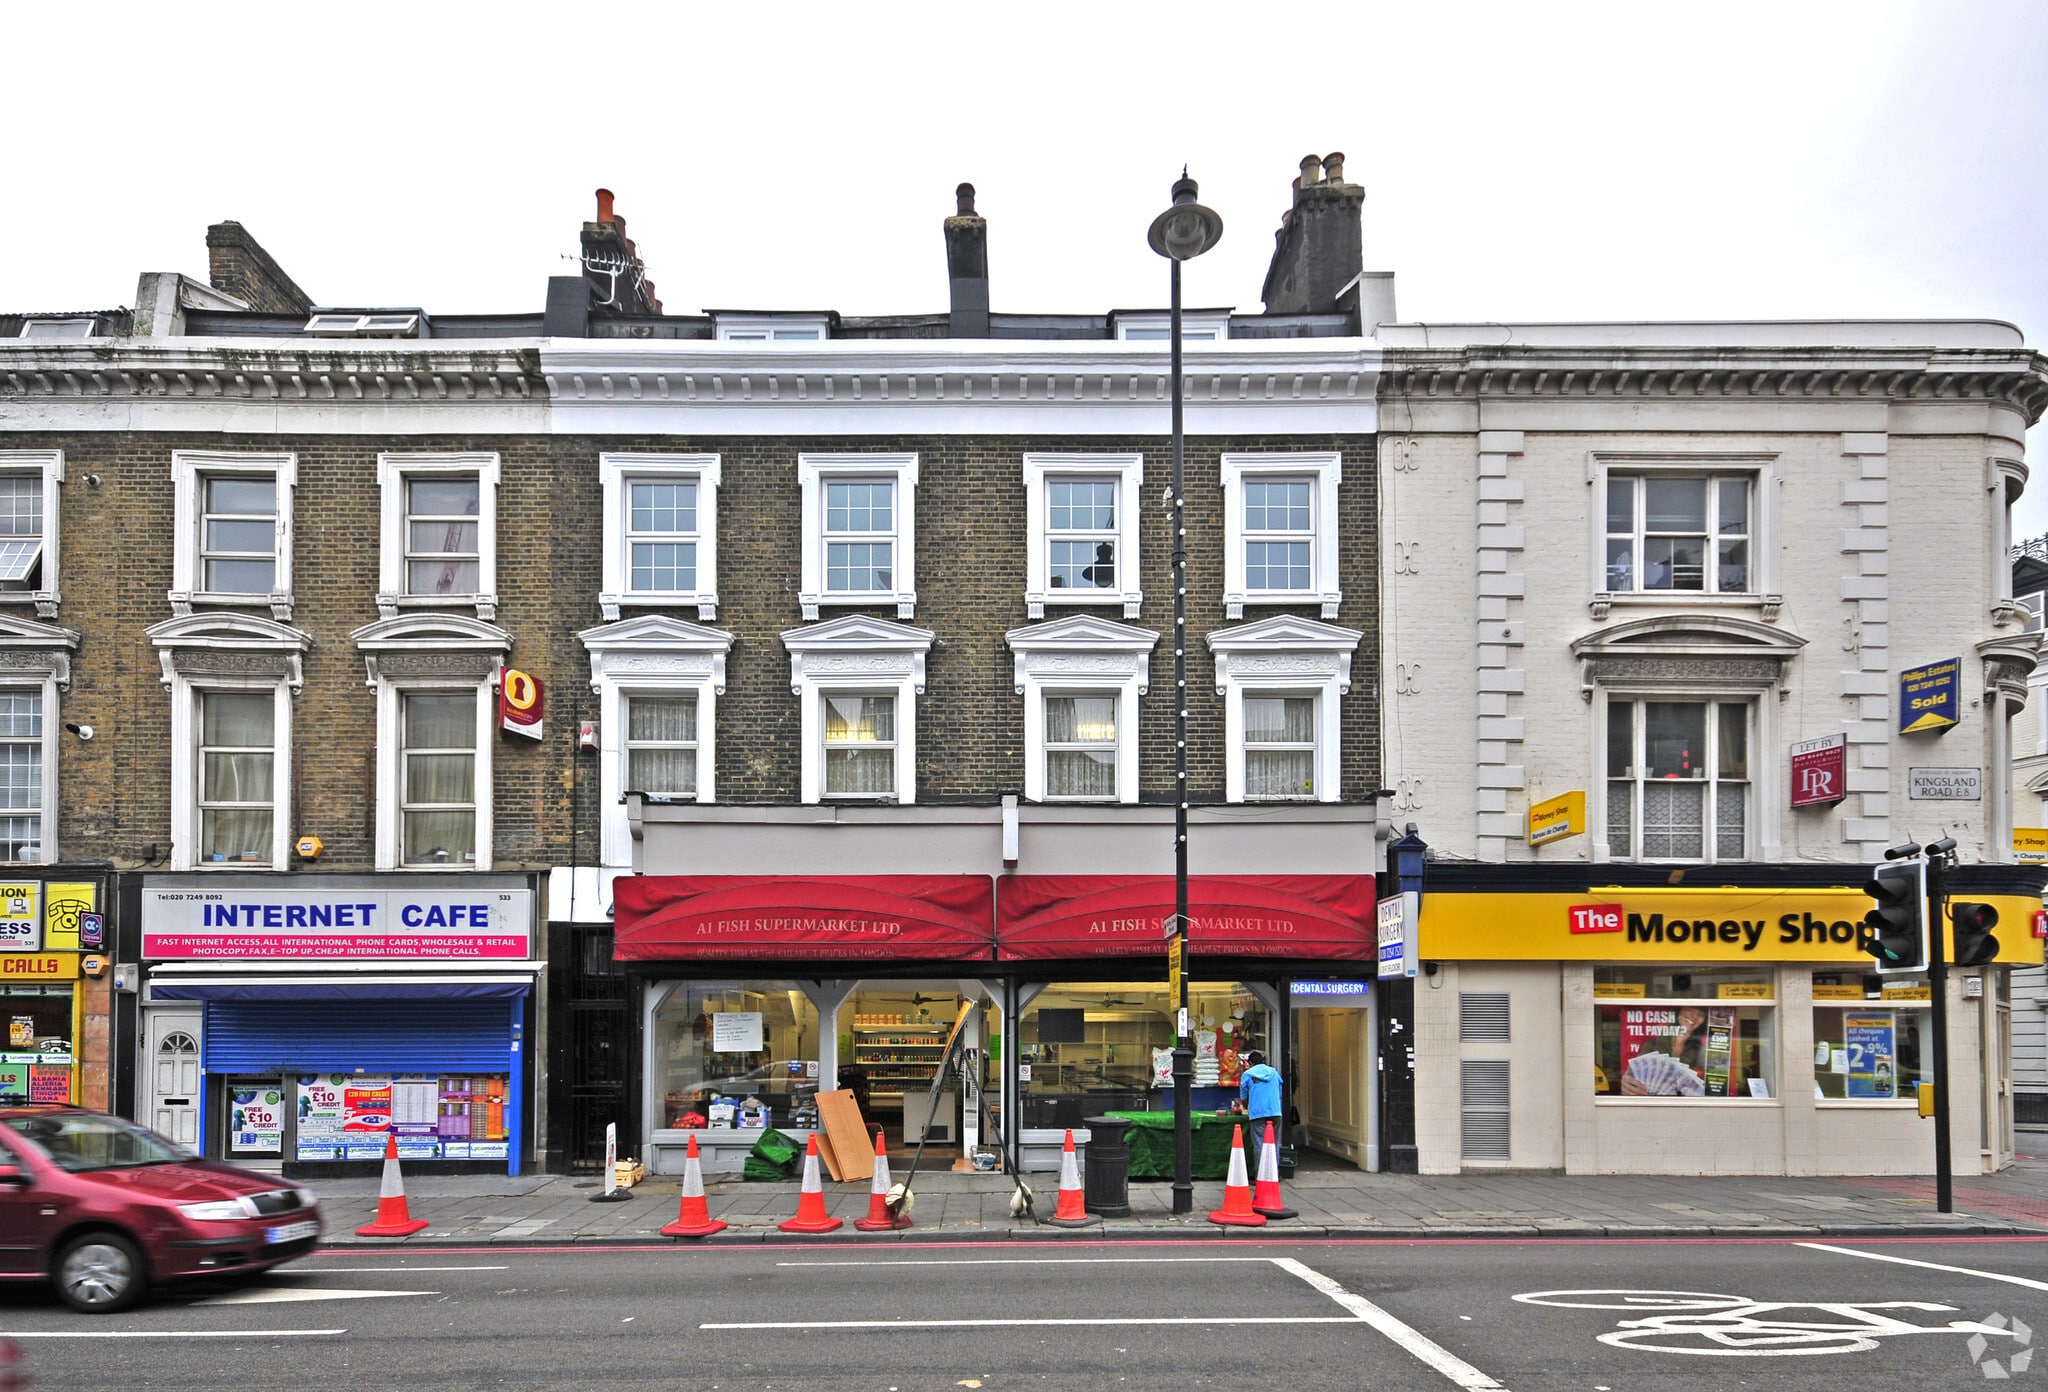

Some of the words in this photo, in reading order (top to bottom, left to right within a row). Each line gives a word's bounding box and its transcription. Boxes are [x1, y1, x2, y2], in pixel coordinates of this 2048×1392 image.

[1928, 664, 1956, 677] Estates
[1911, 692, 1947, 709] Sold
[1801, 741, 1818, 752] LET
[1821, 738, 1834, 748] BY
[1914, 777, 1977, 787] KINGSLAND
[1921, 787, 1952, 797] ROAD
[1556, 806, 1568, 816] Shop
[2025, 837, 2046, 846] Shop
[2020, 852, 2046, 861] Change
[203, 904, 377, 928] INTERNET
[401, 904, 489, 928] CAFE
[1381, 901, 1402, 923] DENTAL
[718, 920, 750, 933] FISH
[754, 918, 868, 932] SUPERMARKET
[872, 921, 904, 935] LTD.
[1112, 919, 1146, 932] FISH
[1268, 919, 1297, 934] LTD.
[1573, 910, 1618, 930] The
[1626, 912, 1766, 952] Money
[1779, 911, 1876, 951] Shop
[1379, 921, 1404, 944] SURGERY
[157, 938, 179, 946] FAST
[182, 938, 224, 946] INTERNET
[281, 938, 353, 946] INTERNATIONAL
[356, 938, 386, 946] PHONE
[476, 938, 484, 946] &
[486, 938, 516, 946] RETAIL
[347, 947, 417, 956] INTERNATIONAL
[420, 947, 450, 956] PHONE
[696, 948, 729, 958] QUALITY
[730, 948, 747, 958] FISH
[777, 948, 818, 958] CHEAPEST
[820, 948, 847, 958] PRICES
[860, 948, 895, 958] LONDON
[3, 958, 59, 973] CALLS
[1293, 983, 1325, 993] DENTAL
[1326, 983, 1364, 993] SURGERY
[1626, 1010, 1643, 1024] NO
[1645, 1010, 1676, 1024] CASH
[1645, 1025, 1688, 1037] PAYDAY?
[1858, 1028, 1885, 1036] cheques
[312, 1092, 335, 1102] £10
[248, 1113, 273, 1123] £10
